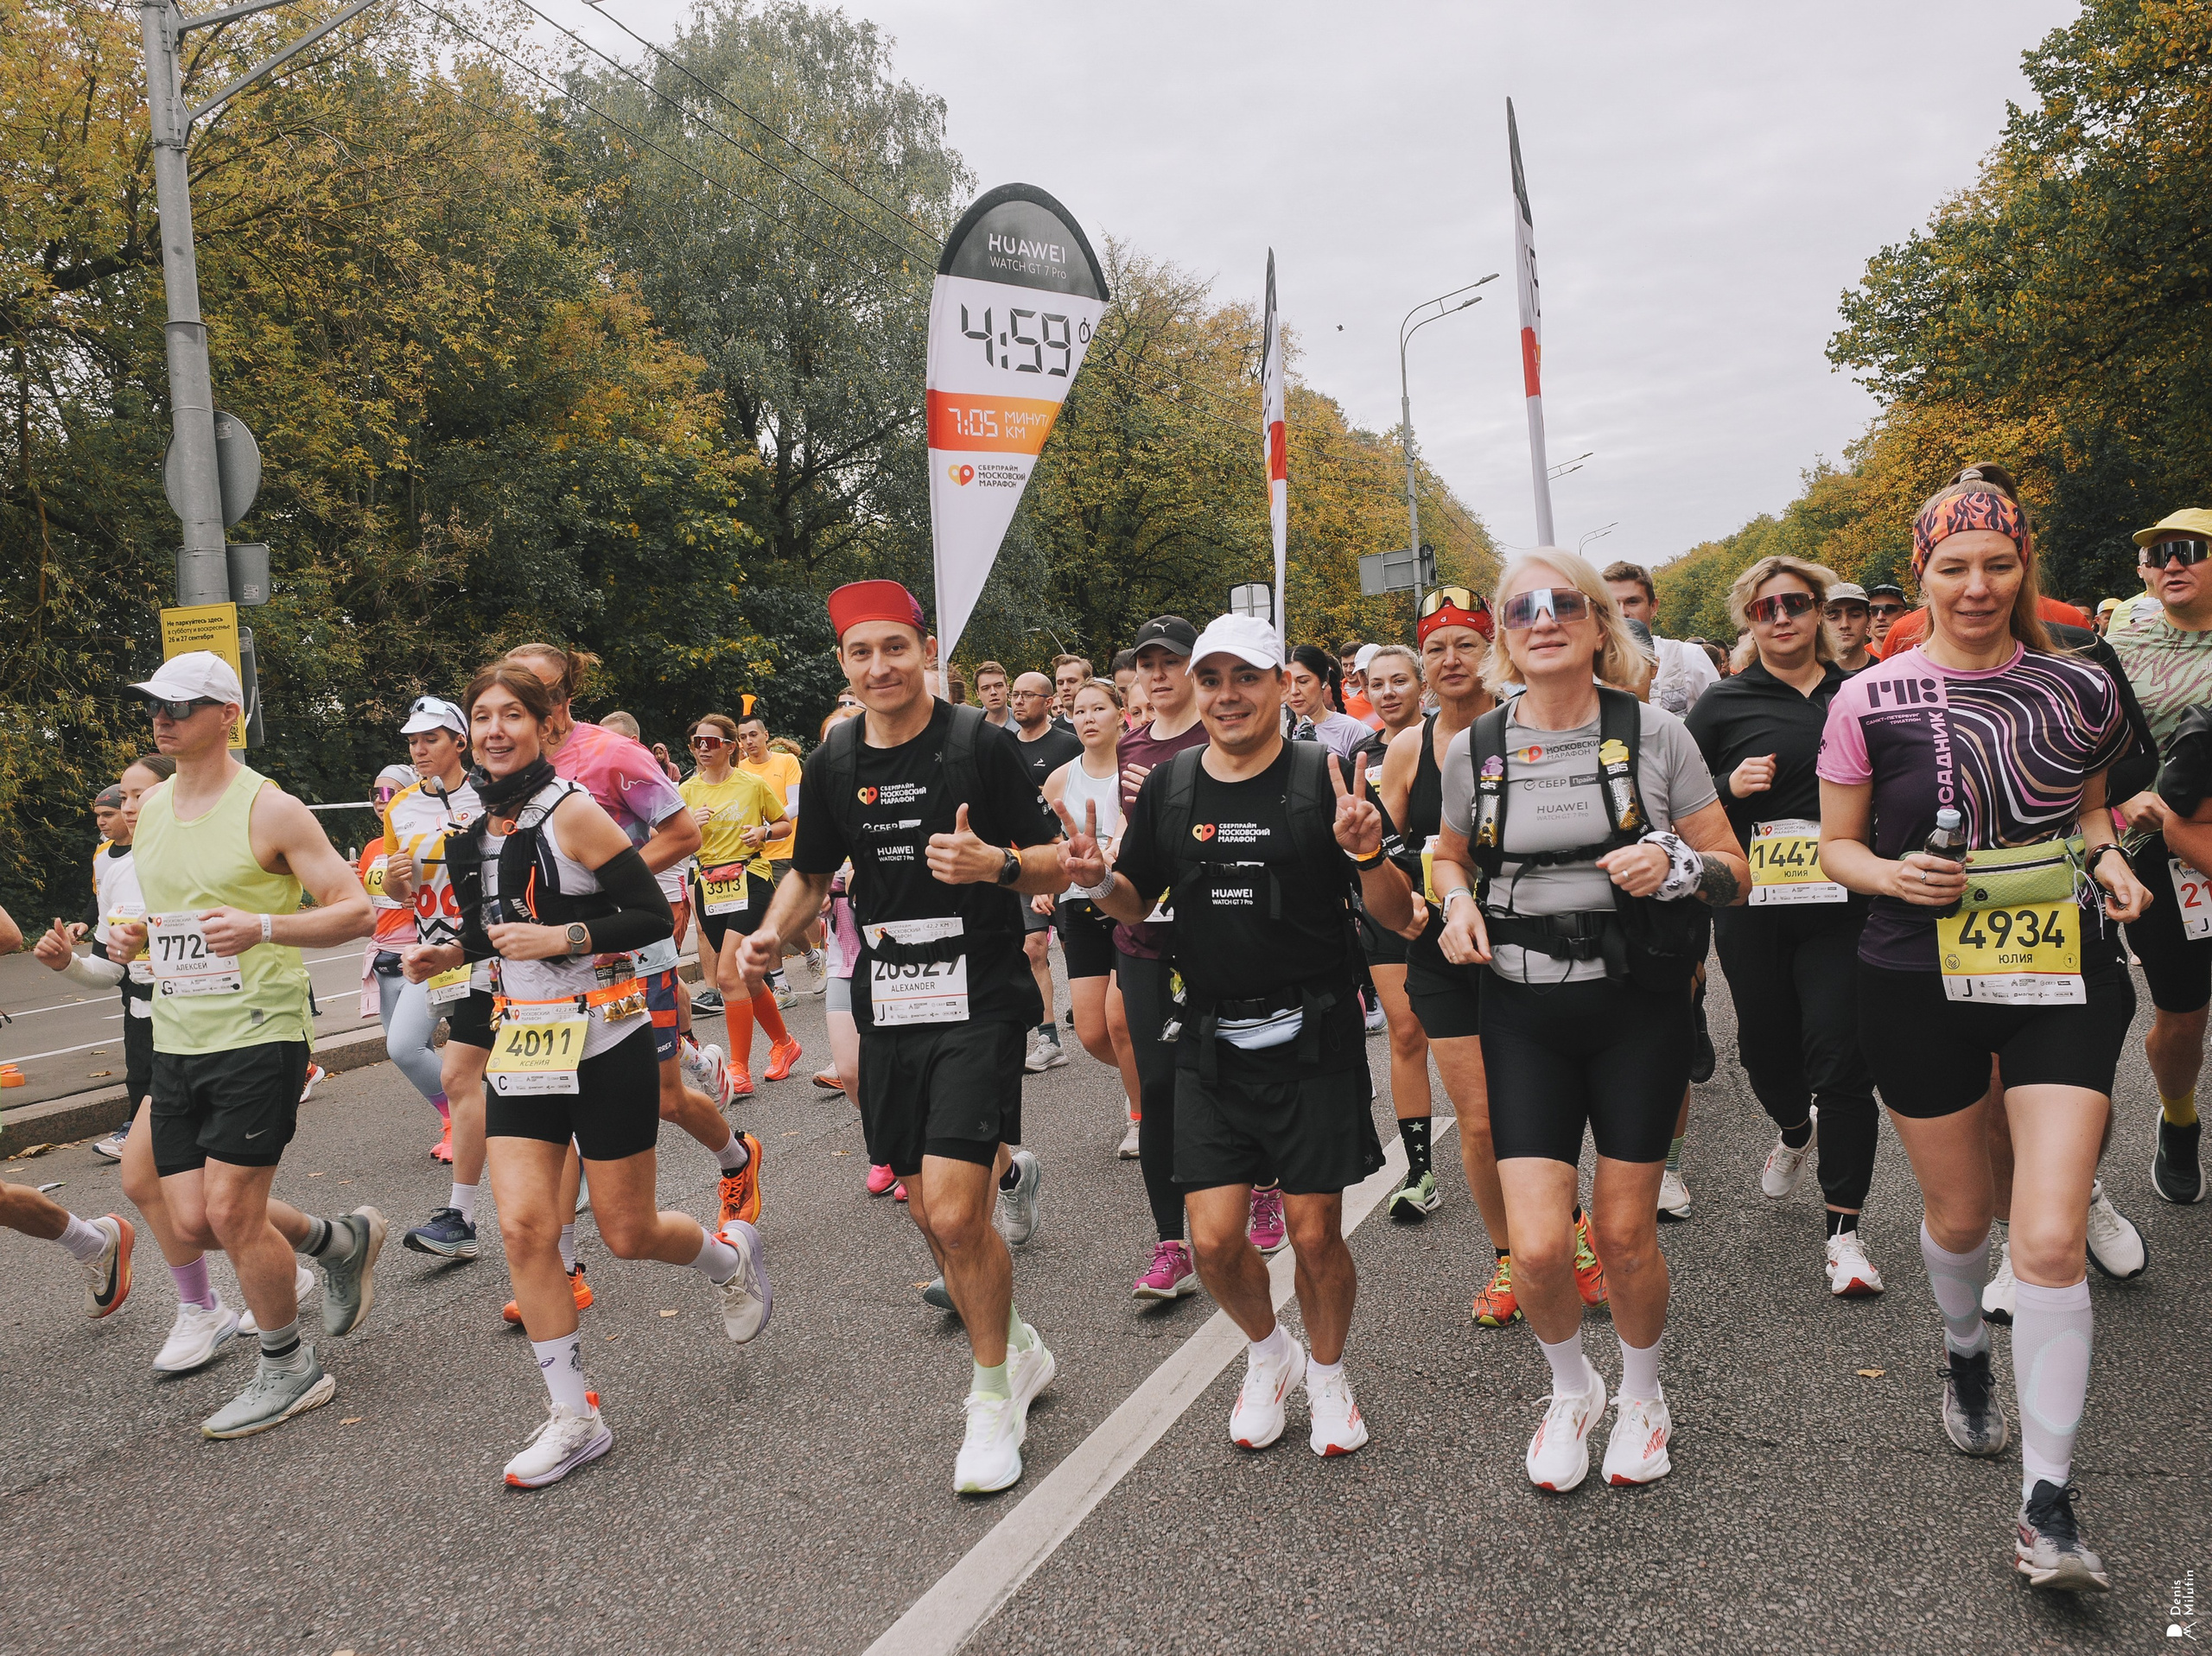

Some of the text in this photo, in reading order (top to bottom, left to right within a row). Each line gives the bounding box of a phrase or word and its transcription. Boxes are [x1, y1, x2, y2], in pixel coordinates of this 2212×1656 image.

[988, 233, 1066, 263] HUAWEI
[989, 256, 1067, 279] WATCH GT 7 Pro
[960, 302, 1071, 378] 4:59
[948, 408, 999, 438] 7:05
[978, 472, 1026, 481] МОСКОВСКИЙ
[175, 619, 207, 627] паркуйтесь
[1866, 713, 1920, 726] САНКТ-ПЕТЕРБУРГ
[1546, 740, 1599, 753] МОСКОВСКИ
[1547, 749, 1591, 759] МАРАФОН
[880, 783, 914, 791] СБЕРПРАЙМ
[1538, 776, 1596, 789] СБЕР Прайм
[880, 786, 927, 797] МОСКОВСКИЙ
[880, 796, 915, 805] МАРАФОН
[1537, 803, 1588, 813] HUAWEI
[877, 846, 914, 855] HUAWEI
[707, 879, 741, 895] 3313
[1211, 889, 1252, 898] HUAWEI
[1760, 888, 1767, 902] J
[511, 898, 531, 917] ANTA
[1959, 910, 2065, 949] 4934
[2201, 917, 2209, 932] J
[157, 934, 216, 961] 772
[1999, 954, 2033, 964] ЮЛИЯ
[175, 962, 208, 972] АЛЕКСЕЙ
[162, 980, 173, 994] G
[892, 981, 935, 993] ALEXANDER
[1963, 979, 1974, 998] J
[880, 1004, 885, 1021] J
[505, 1028, 571, 1056] 4011
[499, 1075, 508, 1090] C
[446, 1229, 465, 1240] HOKA
